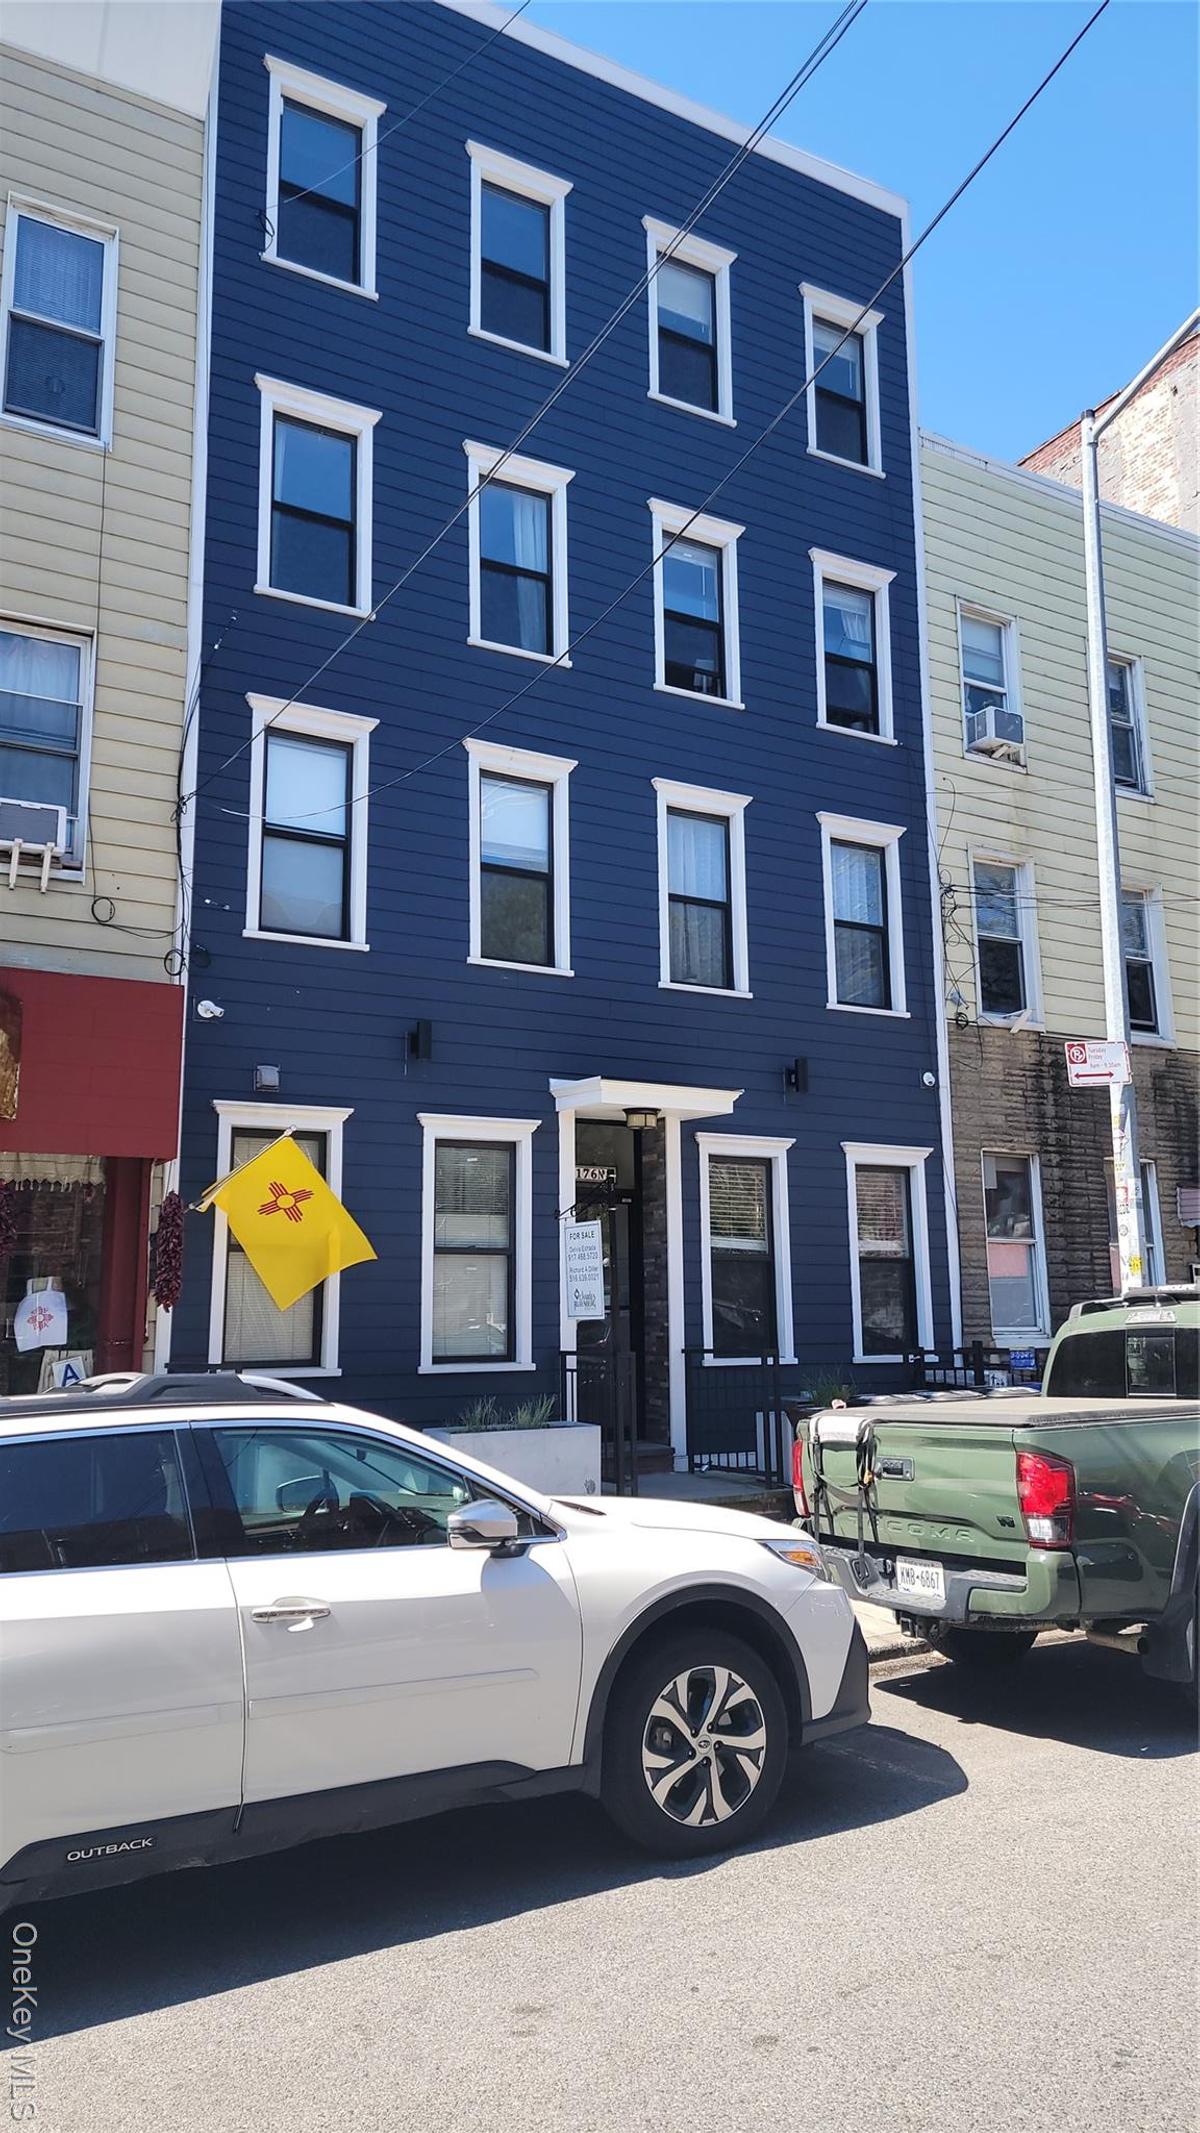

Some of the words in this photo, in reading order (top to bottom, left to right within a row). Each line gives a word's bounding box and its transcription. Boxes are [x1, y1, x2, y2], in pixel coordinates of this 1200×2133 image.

[569, 1231, 580, 1241] FOR
[581, 1230, 595, 1240] SALE
[62, 1363, 80, 1387] A
[67, 1838, 153, 1861] OUTBACK
